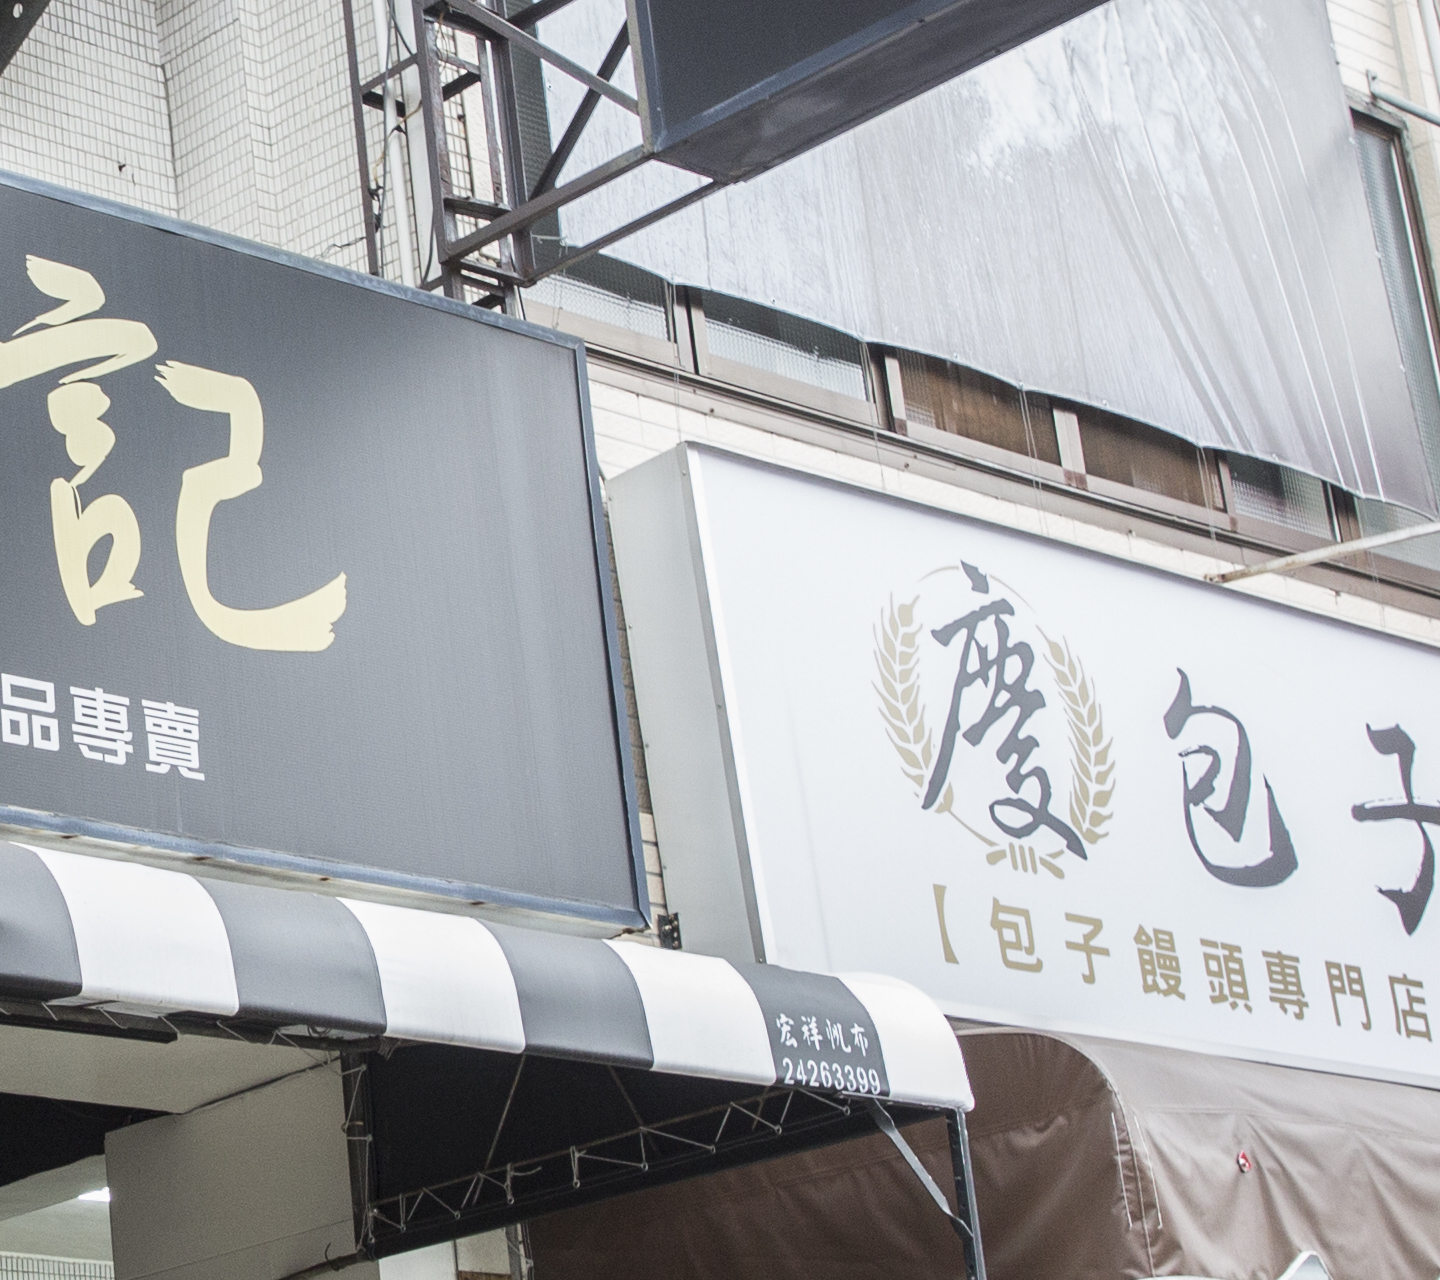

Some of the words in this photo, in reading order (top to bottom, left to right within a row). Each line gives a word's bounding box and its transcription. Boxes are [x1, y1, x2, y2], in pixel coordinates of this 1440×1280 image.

[777, 1011, 869, 1056] 宏祥帆布
[781, 1057, 882, 1094] 24263399
